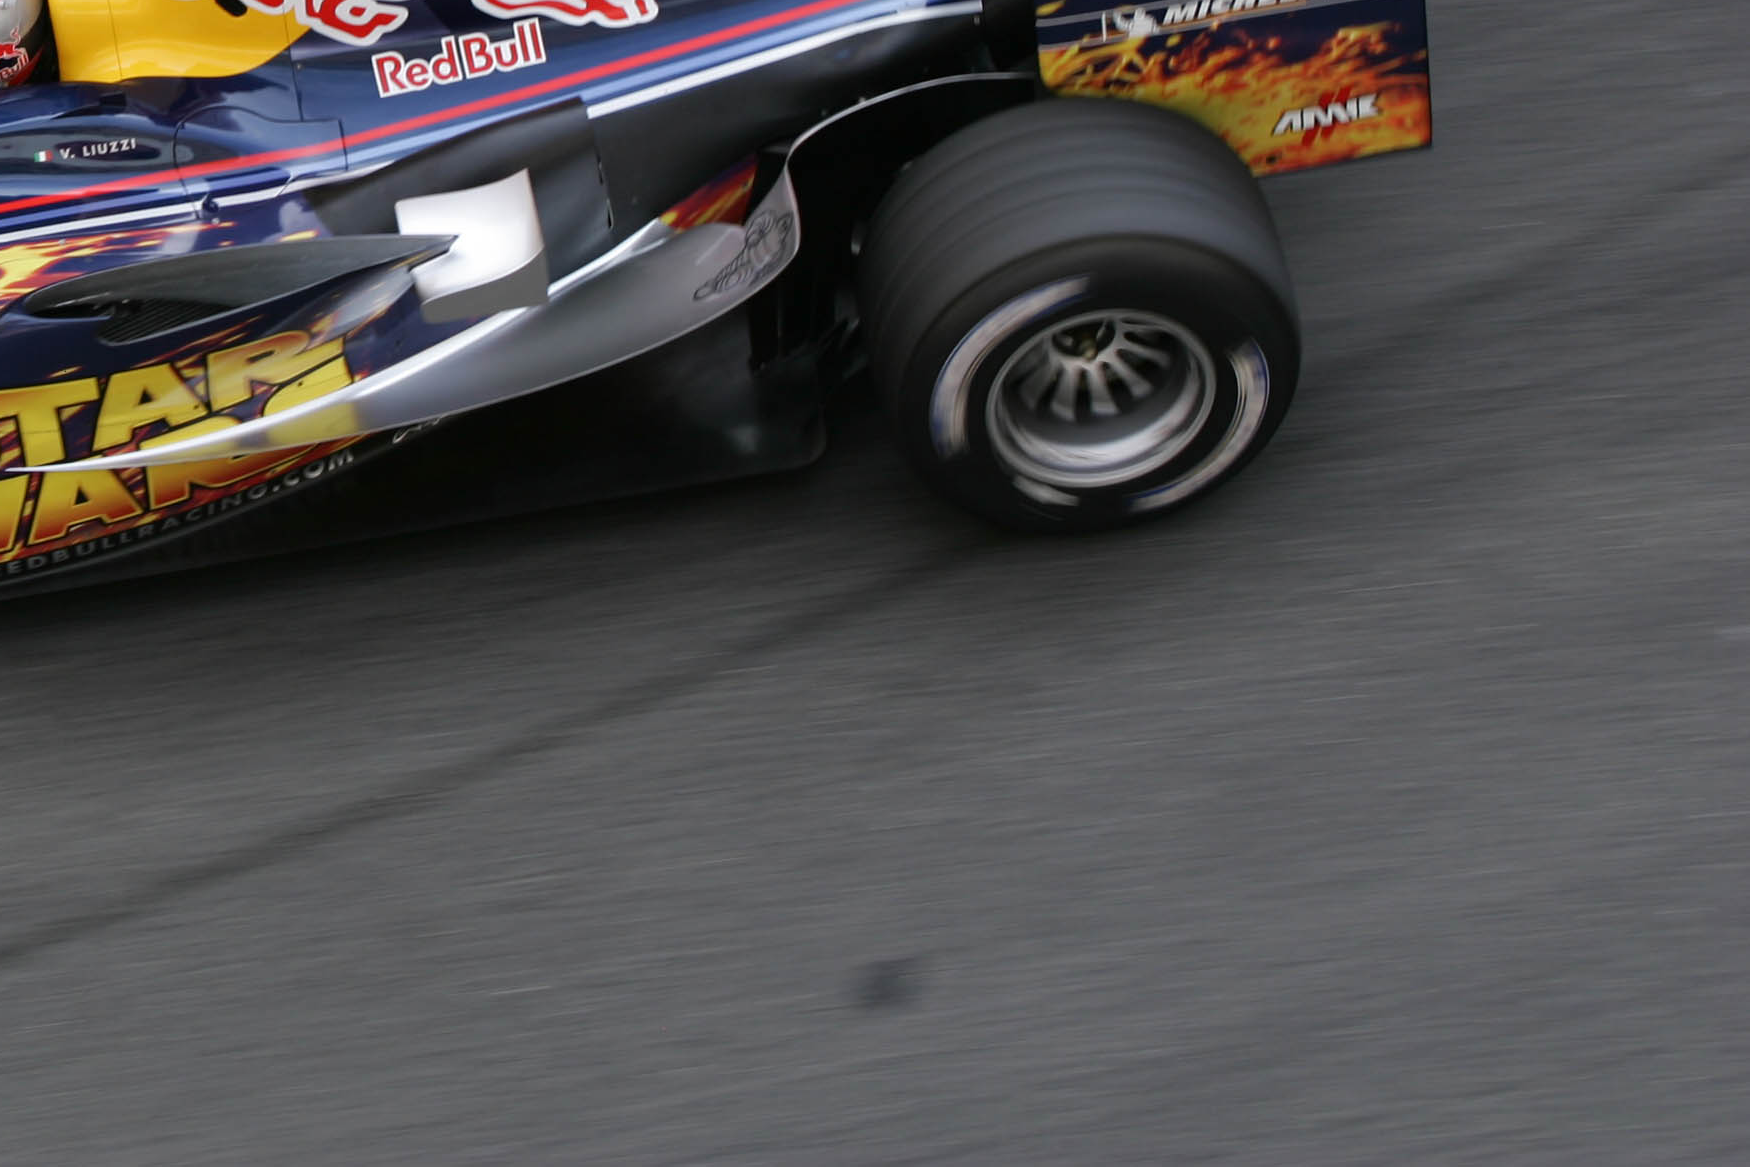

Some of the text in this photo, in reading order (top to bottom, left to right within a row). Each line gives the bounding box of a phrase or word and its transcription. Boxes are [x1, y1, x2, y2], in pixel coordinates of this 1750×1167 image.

[371, 18, 547, 98] Red Bull
[59, 138, 136, 160] V. LIUZZI
